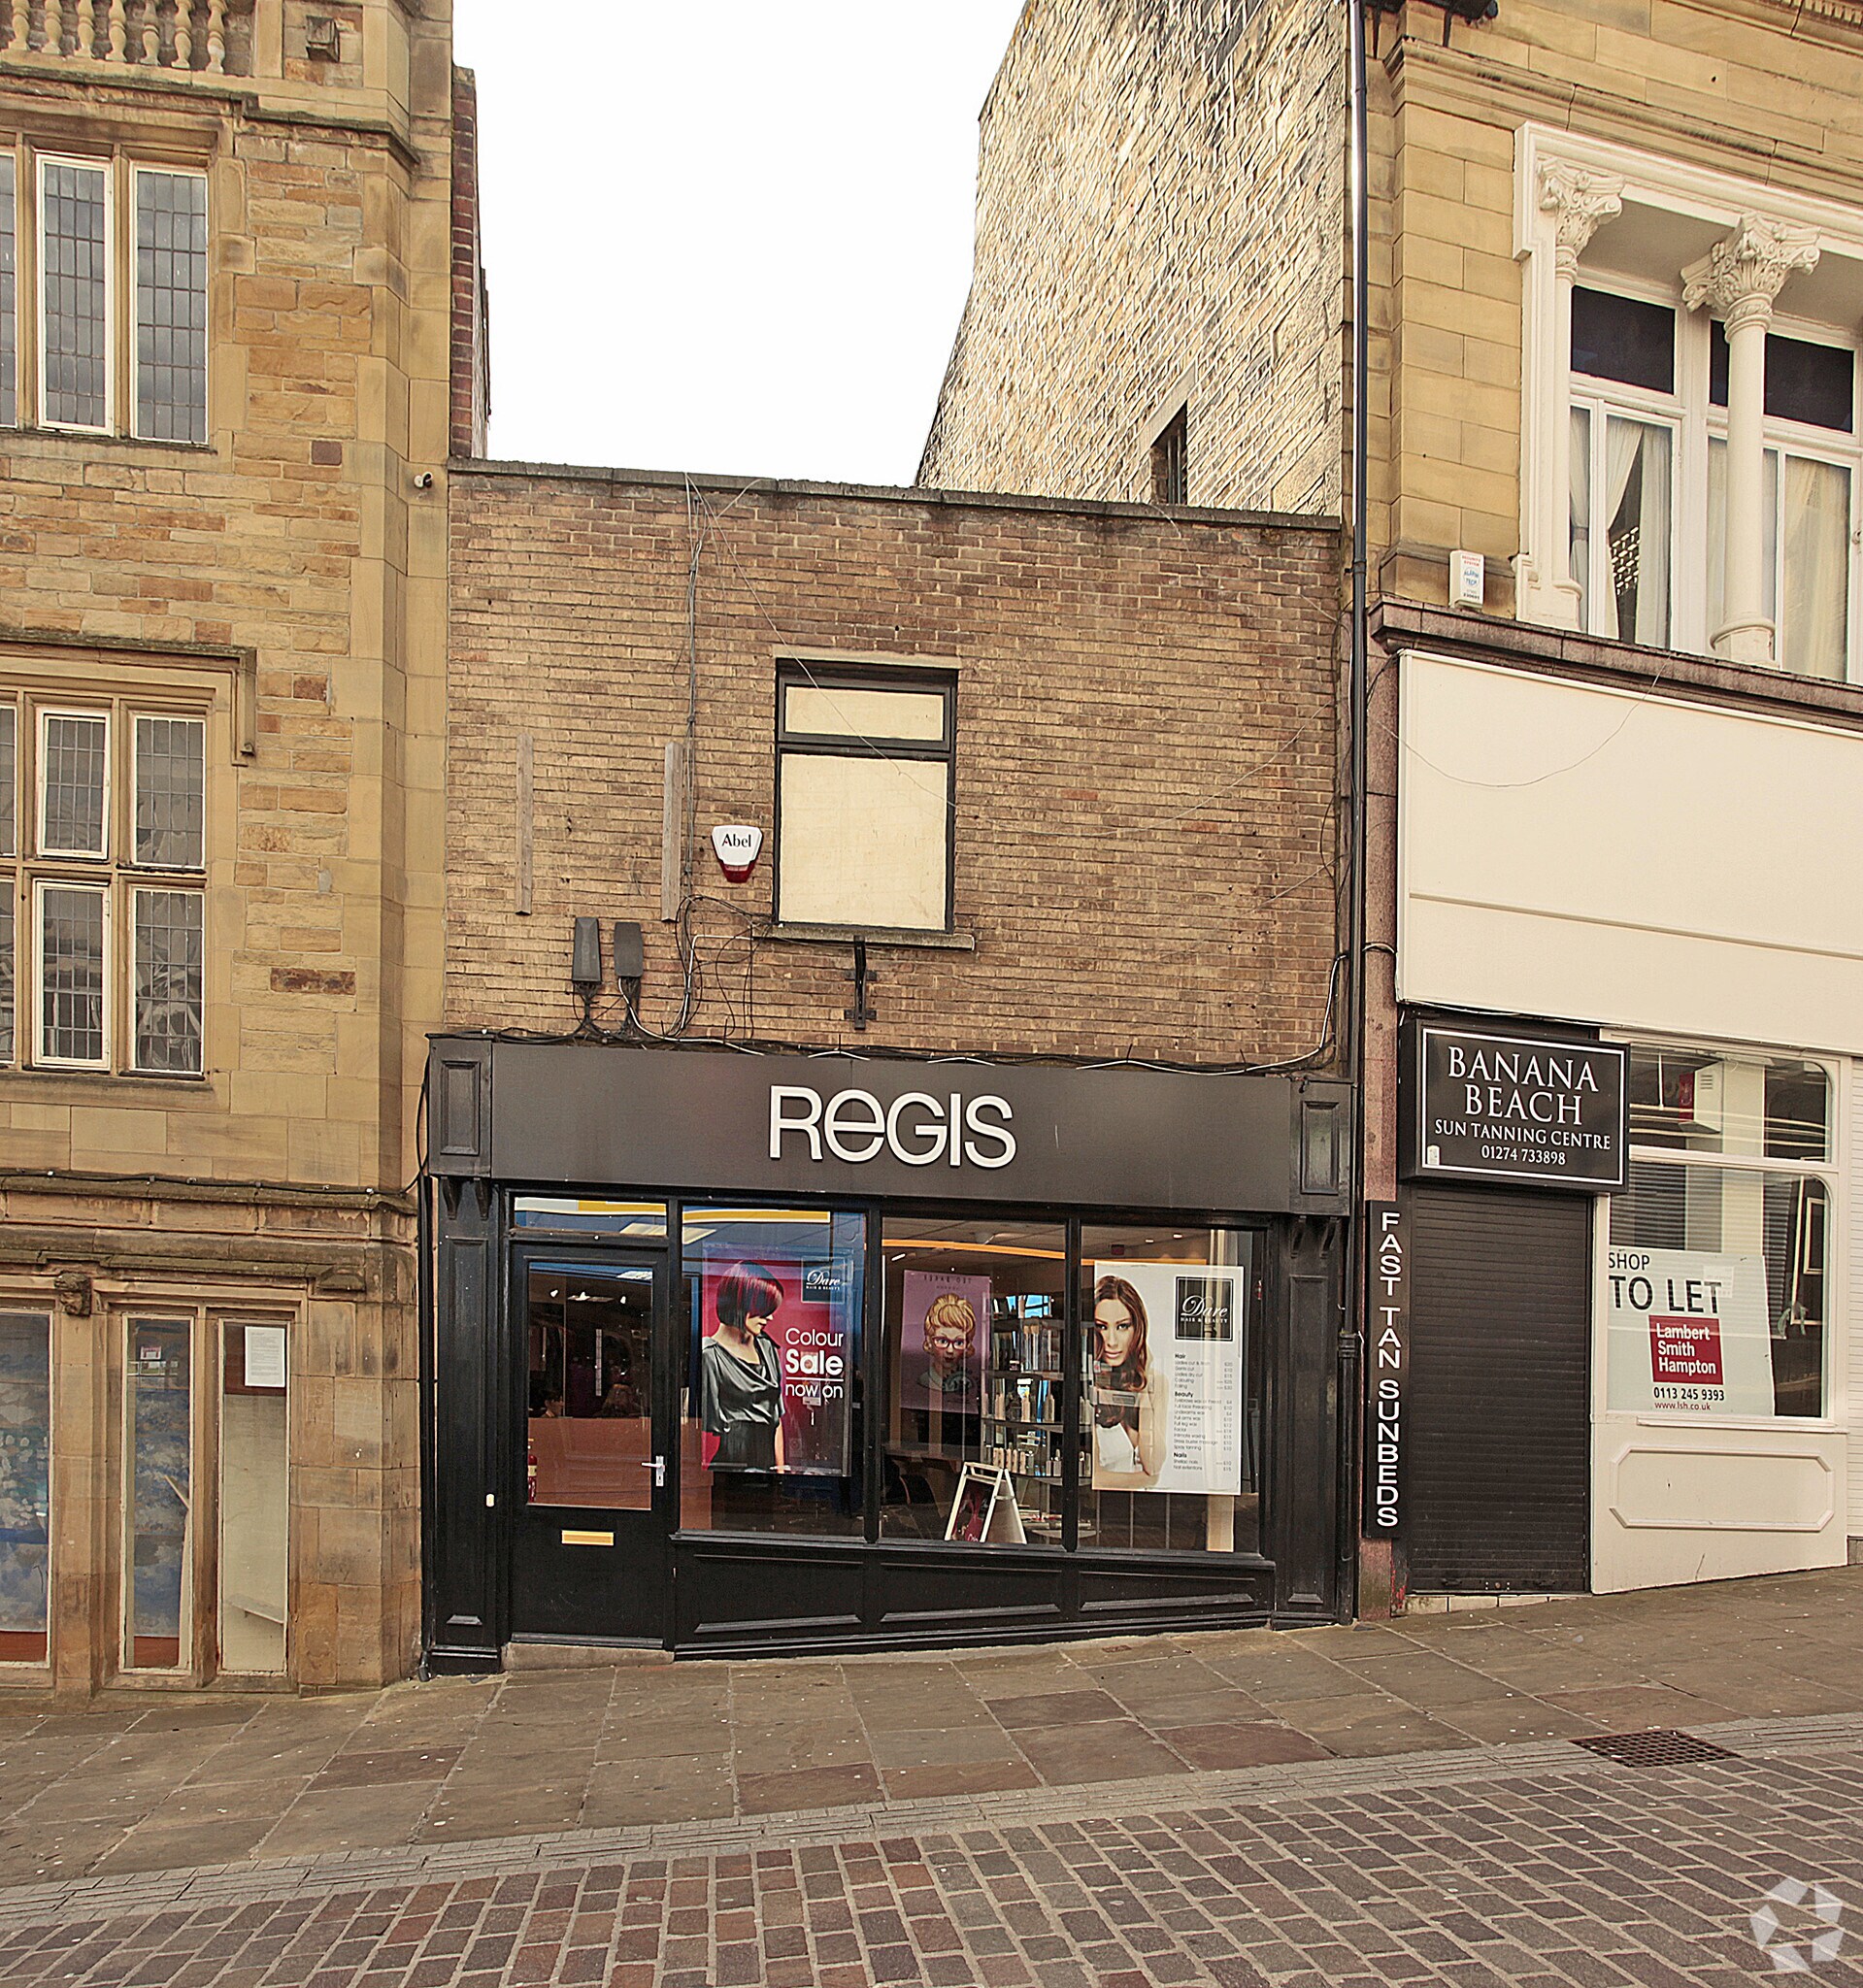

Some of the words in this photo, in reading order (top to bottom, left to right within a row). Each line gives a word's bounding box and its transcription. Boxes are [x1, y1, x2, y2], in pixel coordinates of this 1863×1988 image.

[721, 833, 751, 847] Abel
[1448, 1045, 1599, 1093] BANANA
[1464, 1083, 1583, 1126] BEACH
[1434, 1119, 1467, 1137] SUN
[1470, 1123, 1547, 1144] TANNING
[1550, 1131, 1611, 1150] CENTRE
[1481, 1144, 1518, 1161] 01274
[1521, 1148, 1566, 1165] 733898
[1379, 1212, 1403, 1296] FAST
[1608, 1252, 1650, 1271] SHOP
[806, 1269, 840, 1286] Dare
[1609, 1275, 1653, 1311] TO
[1667, 1278, 1722, 1314] LET
[1181, 1294, 1228, 1317] Dare
[785, 1327, 844, 1347] Colour
[1378, 1306, 1402, 1370] TAN
[1656, 1322, 1711, 1341] Lambert
[1657, 1340, 1695, 1357] Smith
[785, 1348, 844, 1375] Sale
[1658, 1356, 1716, 1376] Hampton
[784, 1383, 819, 1398] now
[822, 1384, 843, 1399] on
[1653, 1387, 1678, 1399] 0113
[1680, 1388, 1699, 1400] 245
[1701, 1389, 1725, 1401] 9393
[1654, 1401, 1712, 1410] www.lsh.co.uk
[1376, 1379, 1400, 1528] SUNBEDS
